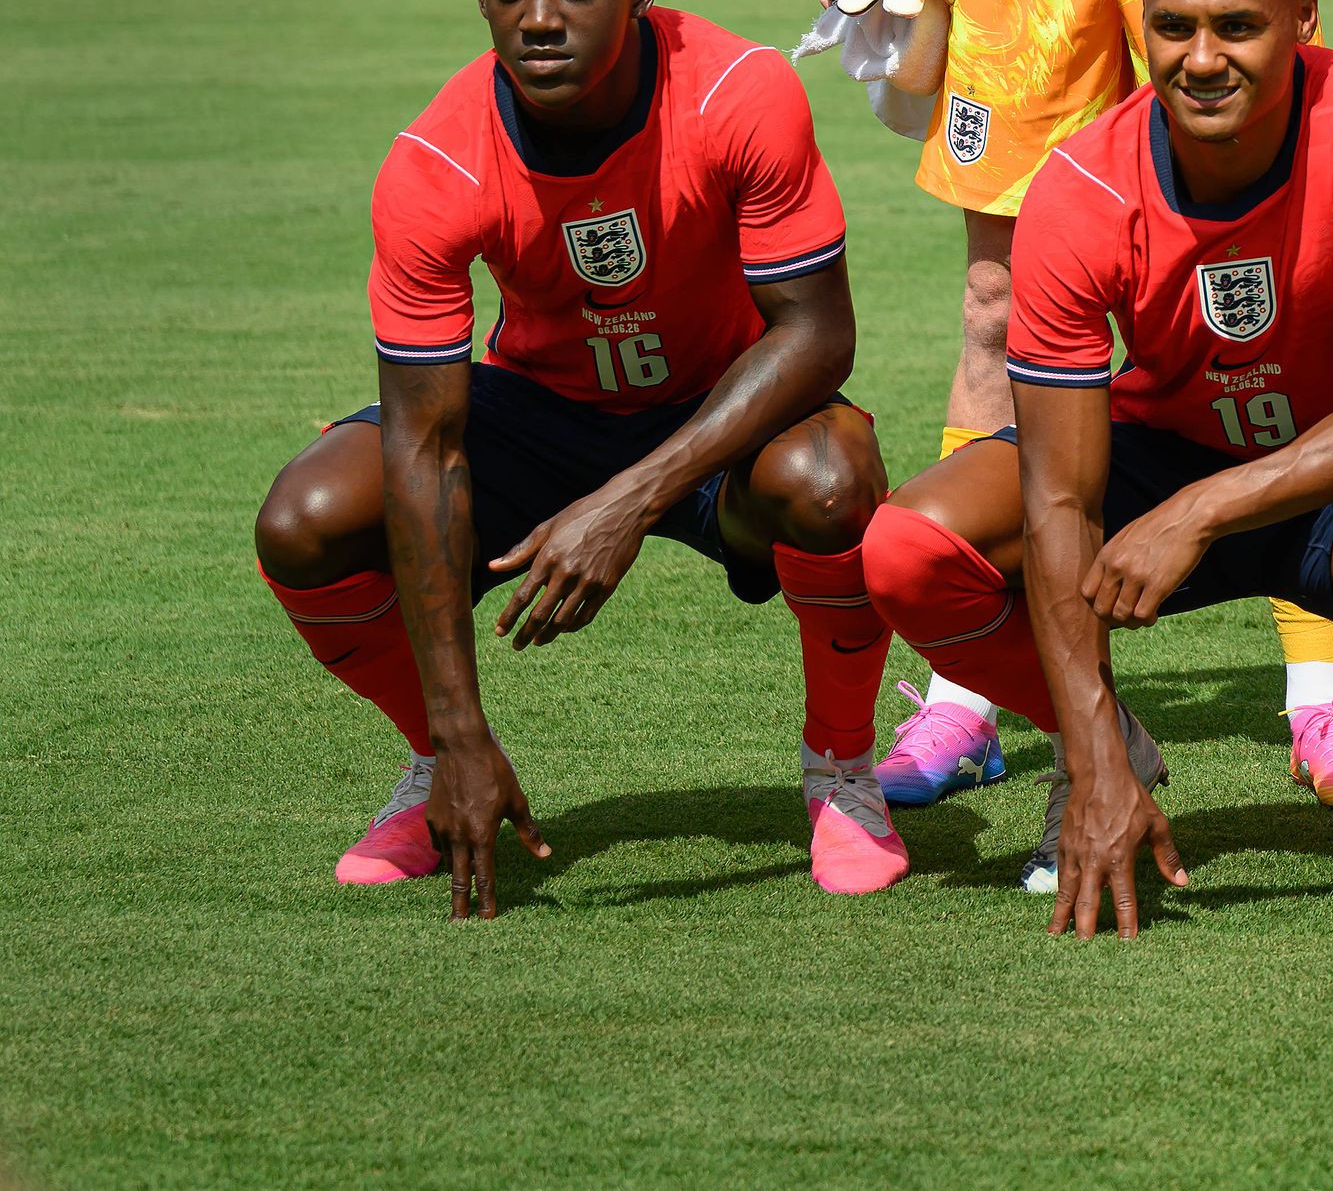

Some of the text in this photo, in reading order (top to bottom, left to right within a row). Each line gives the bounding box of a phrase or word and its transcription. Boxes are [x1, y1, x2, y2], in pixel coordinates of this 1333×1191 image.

[581, 307, 657, 326] NEW ZEALAND
[585, 332, 671, 393] 16
[1205, 363, 1282, 385] NEW ZEALAND
[1210, 391, 1298, 448] 19
